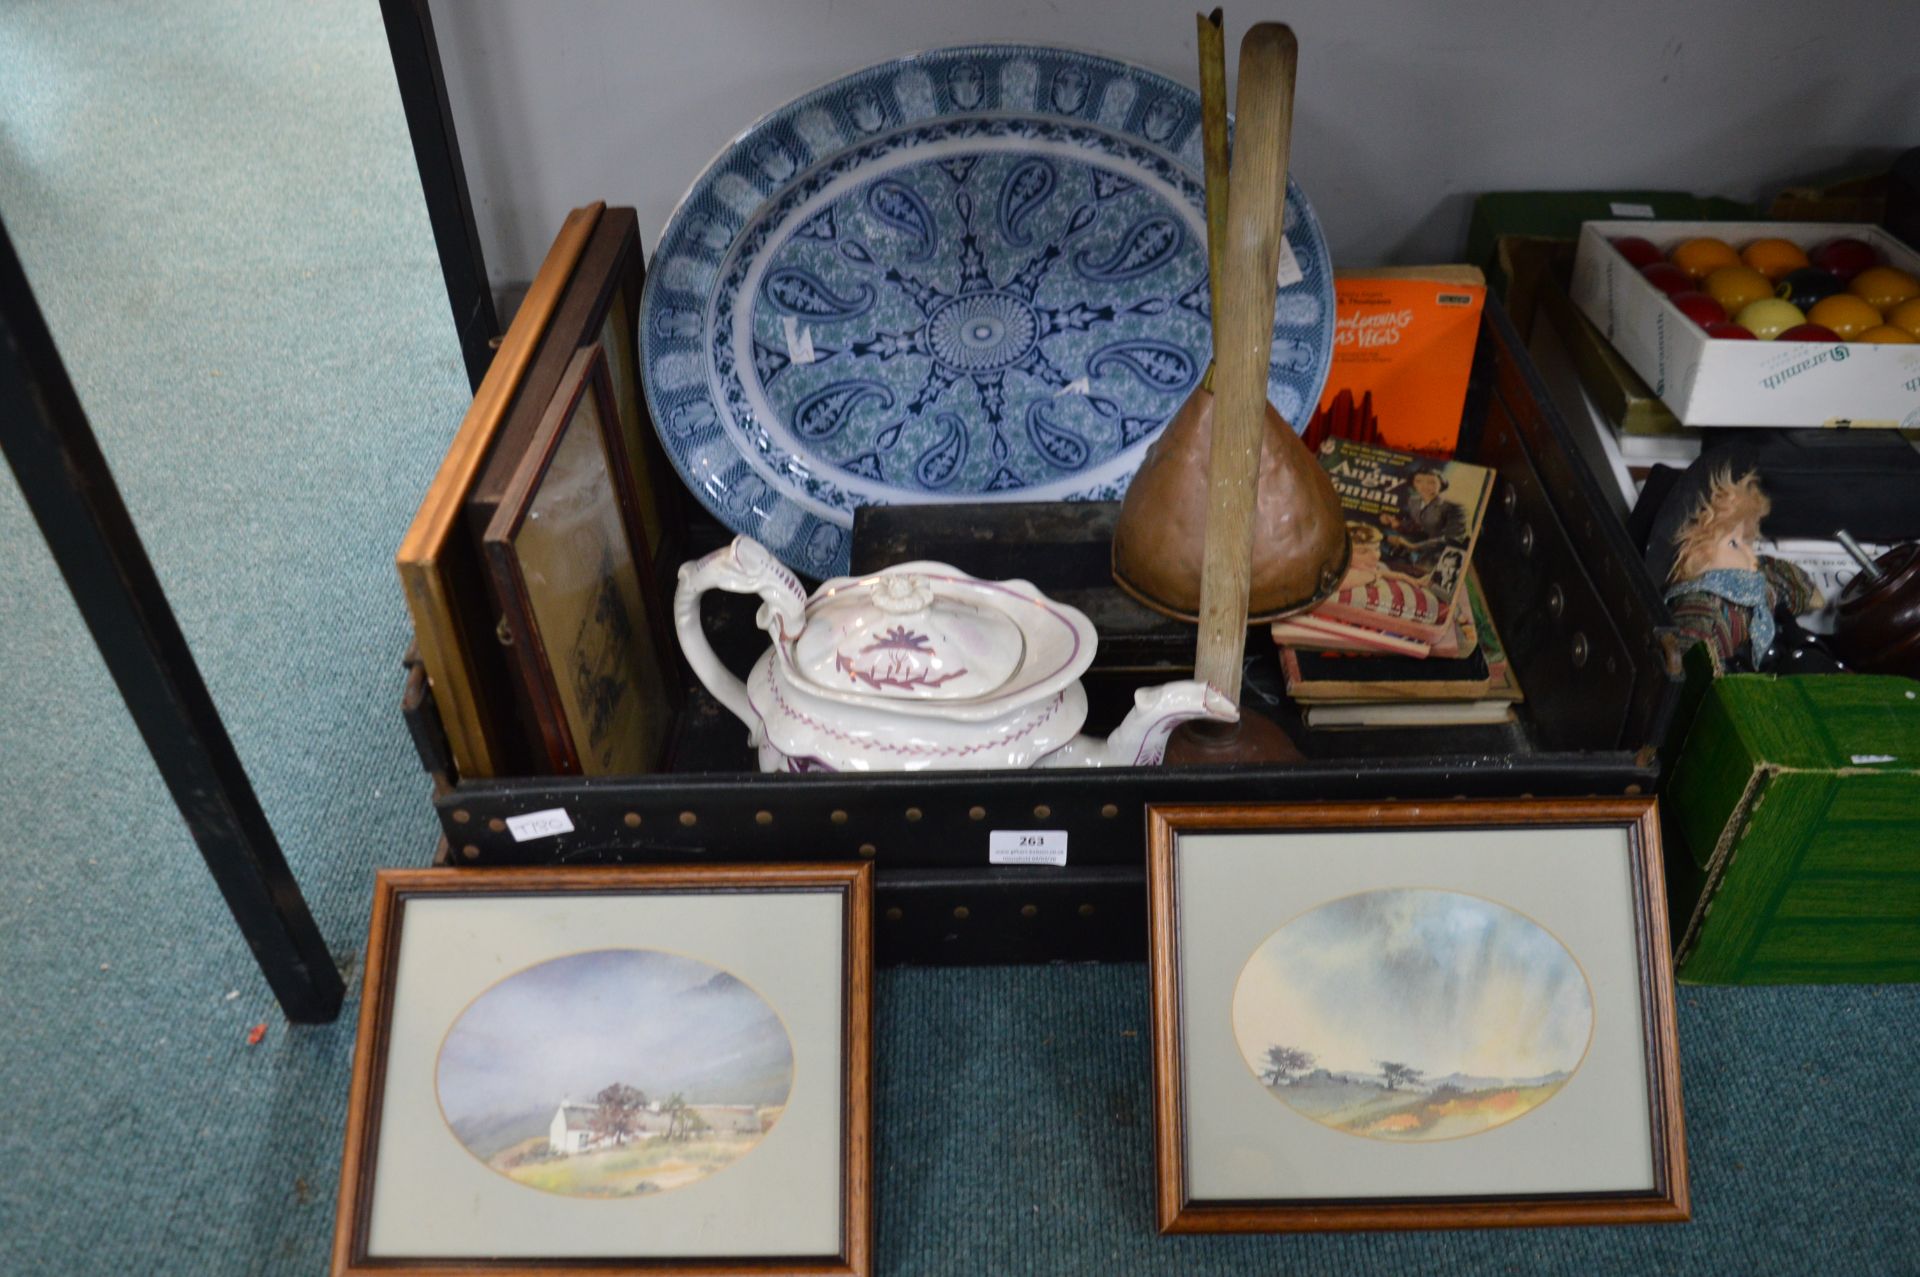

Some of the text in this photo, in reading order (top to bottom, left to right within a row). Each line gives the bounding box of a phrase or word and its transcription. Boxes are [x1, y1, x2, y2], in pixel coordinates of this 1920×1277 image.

[1333, 327, 1400, 348] AS VEGAS
[1355, 457, 1378, 468] THE
[1328, 460, 1407, 492] Angry
[1331, 477, 1399, 505] oman
[1019, 835, 1044, 847] 263
